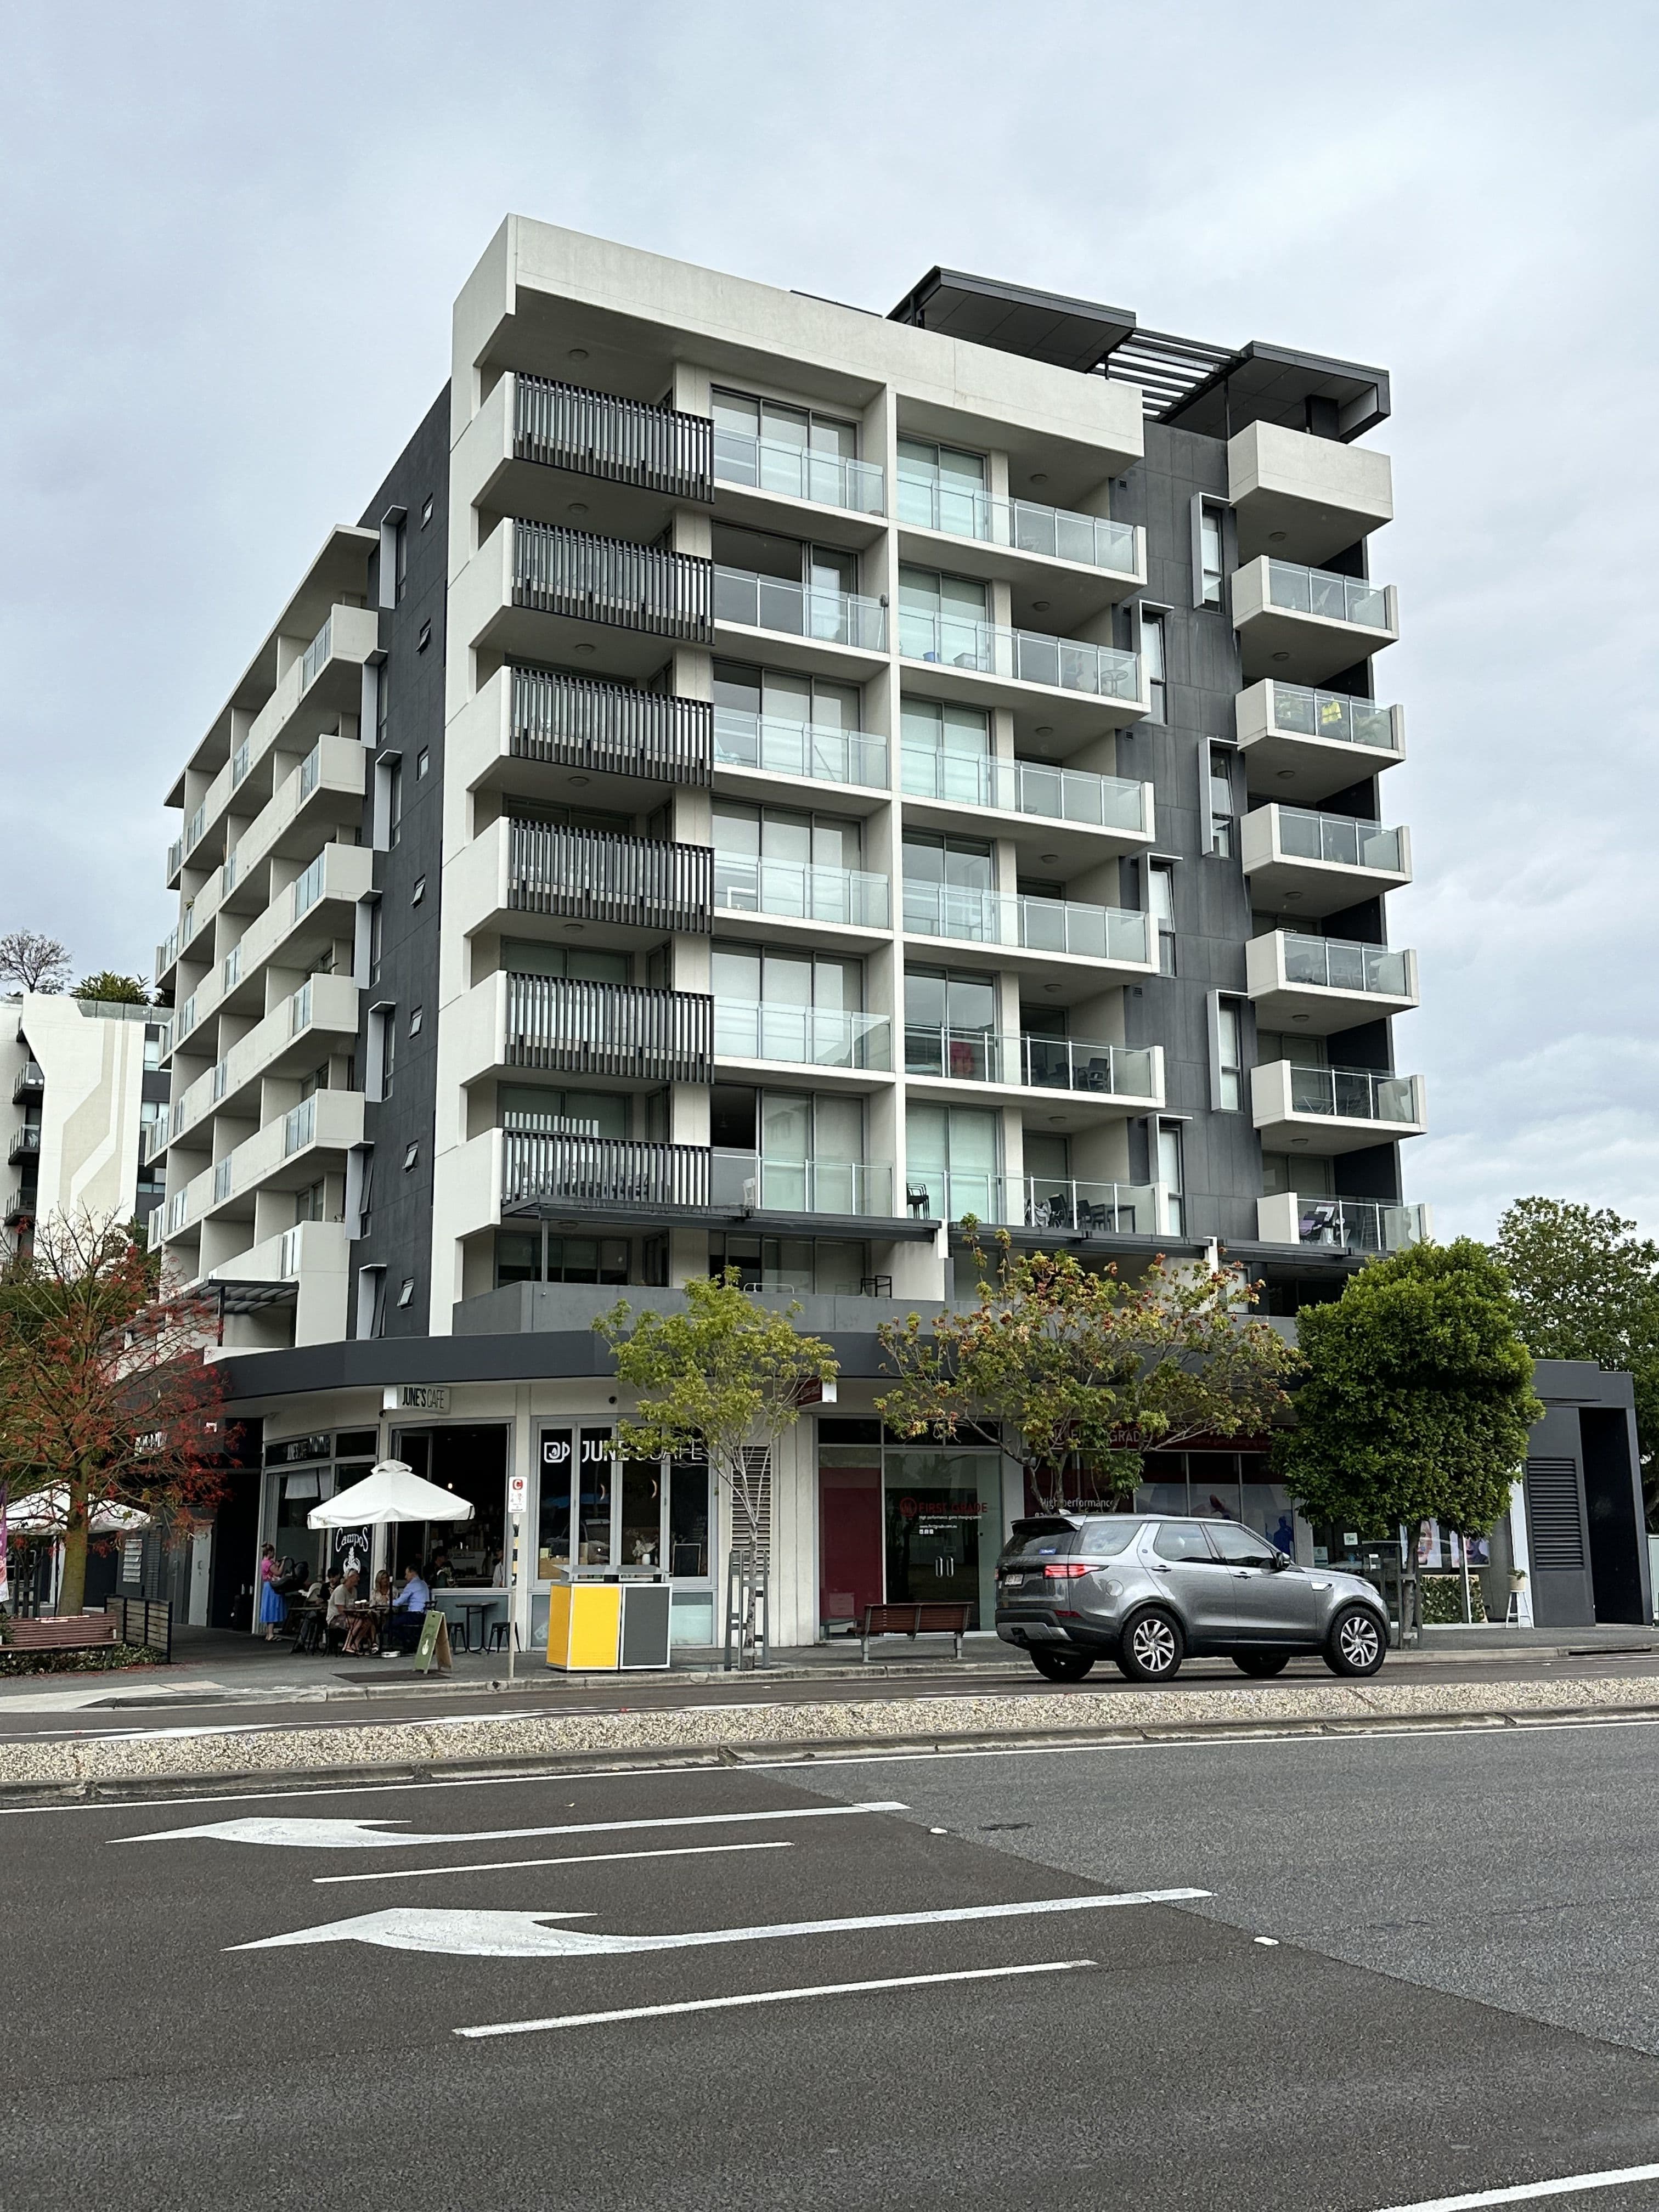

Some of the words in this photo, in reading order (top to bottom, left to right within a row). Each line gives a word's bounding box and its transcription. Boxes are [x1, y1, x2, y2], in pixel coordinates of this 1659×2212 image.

[402, 1386, 426, 1407] JUNE'S
[427, 1389, 444, 1409] CAFE
[919, 1502, 947, 1513] FIRST
[952, 1502, 988, 1513] GRADE
